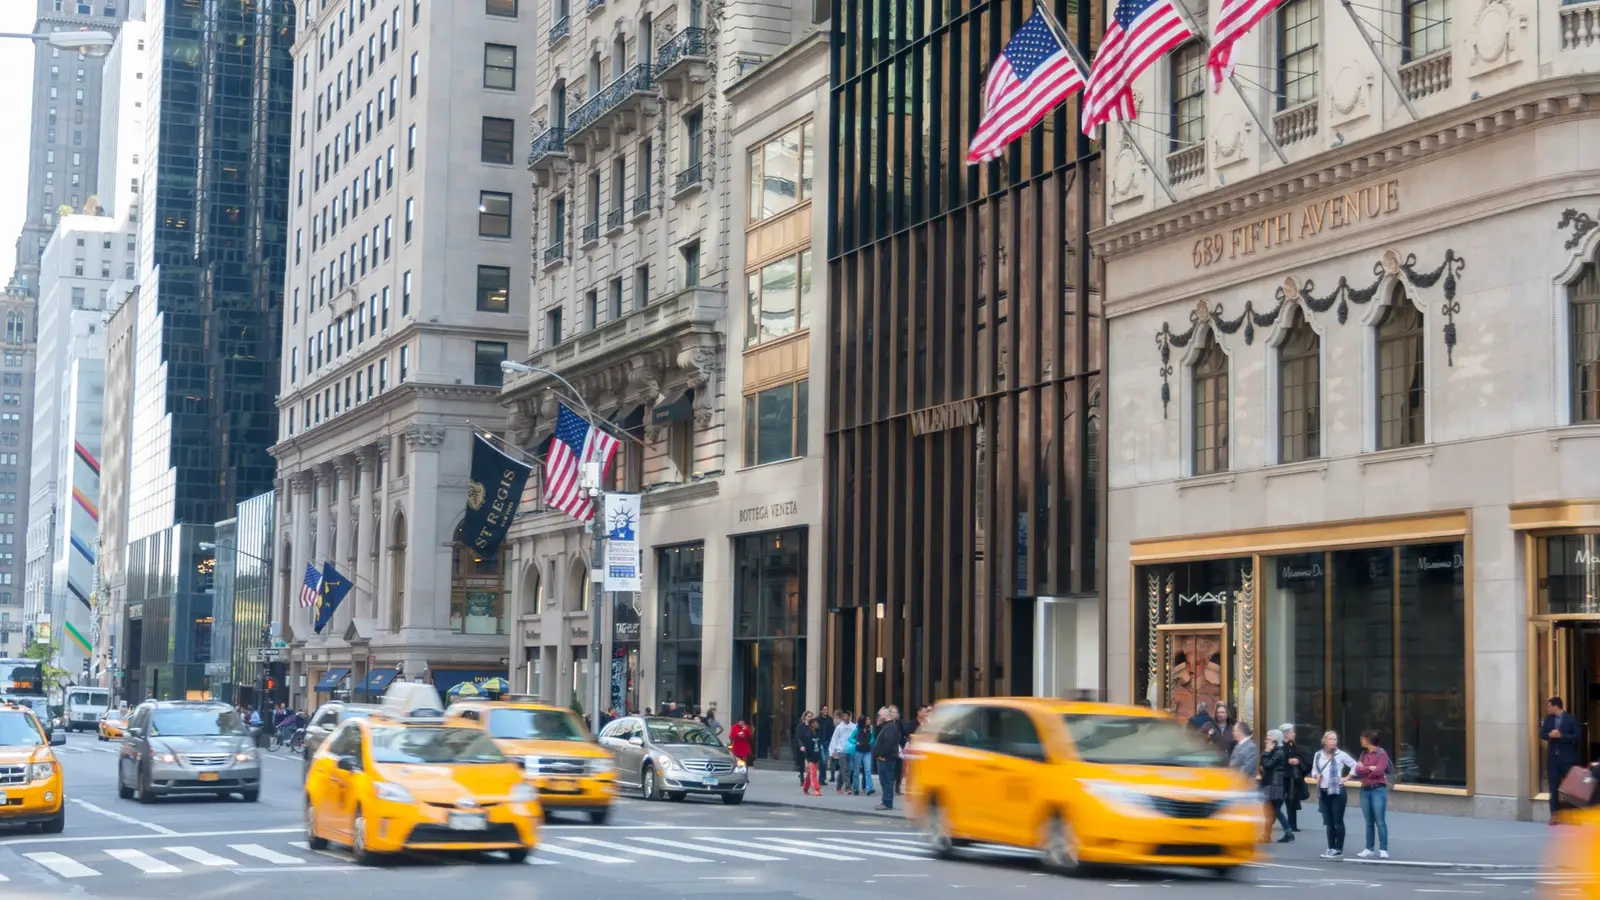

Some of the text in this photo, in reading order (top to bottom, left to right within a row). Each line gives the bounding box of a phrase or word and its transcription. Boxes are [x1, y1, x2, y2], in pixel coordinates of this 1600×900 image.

[1192, 178, 1400, 268] 689 FIFTH AVENUE
[911, 400, 979, 437] VALENTINO
[487, 468, 516, 525] REGIS
[739, 501, 798, 523] BOTTEGA VENETA
